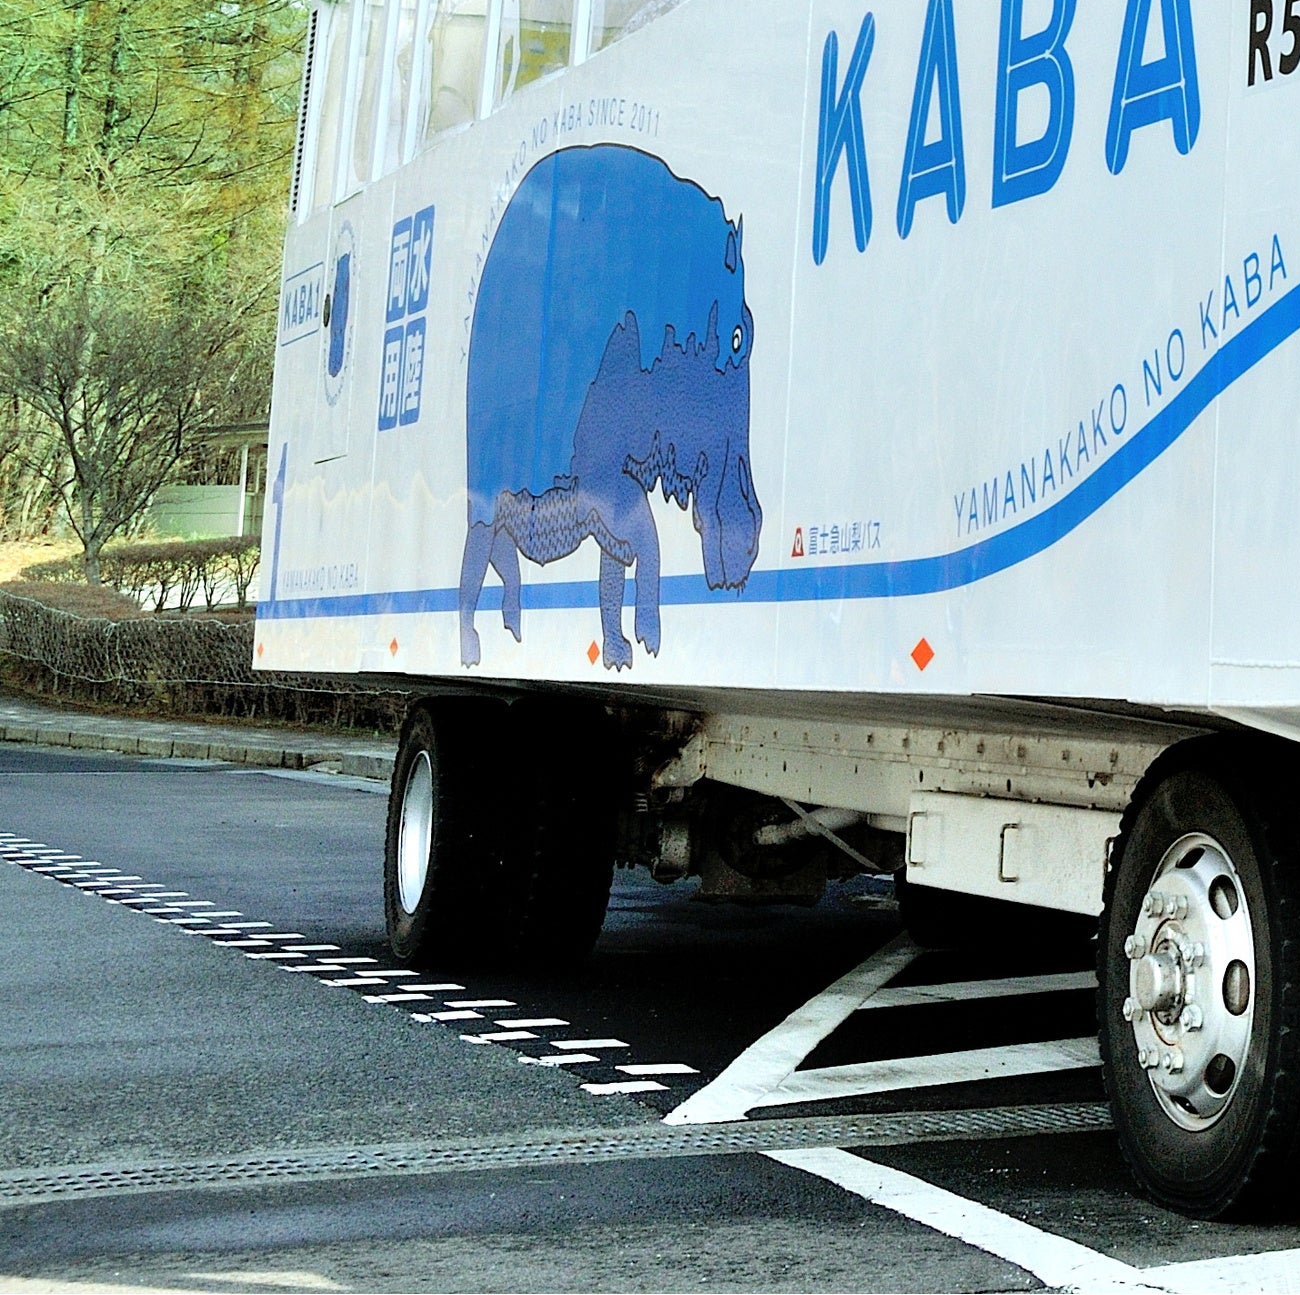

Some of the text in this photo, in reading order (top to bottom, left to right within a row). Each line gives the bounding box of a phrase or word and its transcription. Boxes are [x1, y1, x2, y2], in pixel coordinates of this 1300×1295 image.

[531, 117, 548, 152] NO
[553, 104, 582, 136] KABA
[588, 98, 626, 127] SINCE
[630, 104, 660, 137] 2011
[953, 383, 1128, 538] YAMANAKAKO
[1142, 327, 1186, 408] NO
[1200, 233, 1288, 351] KABA
